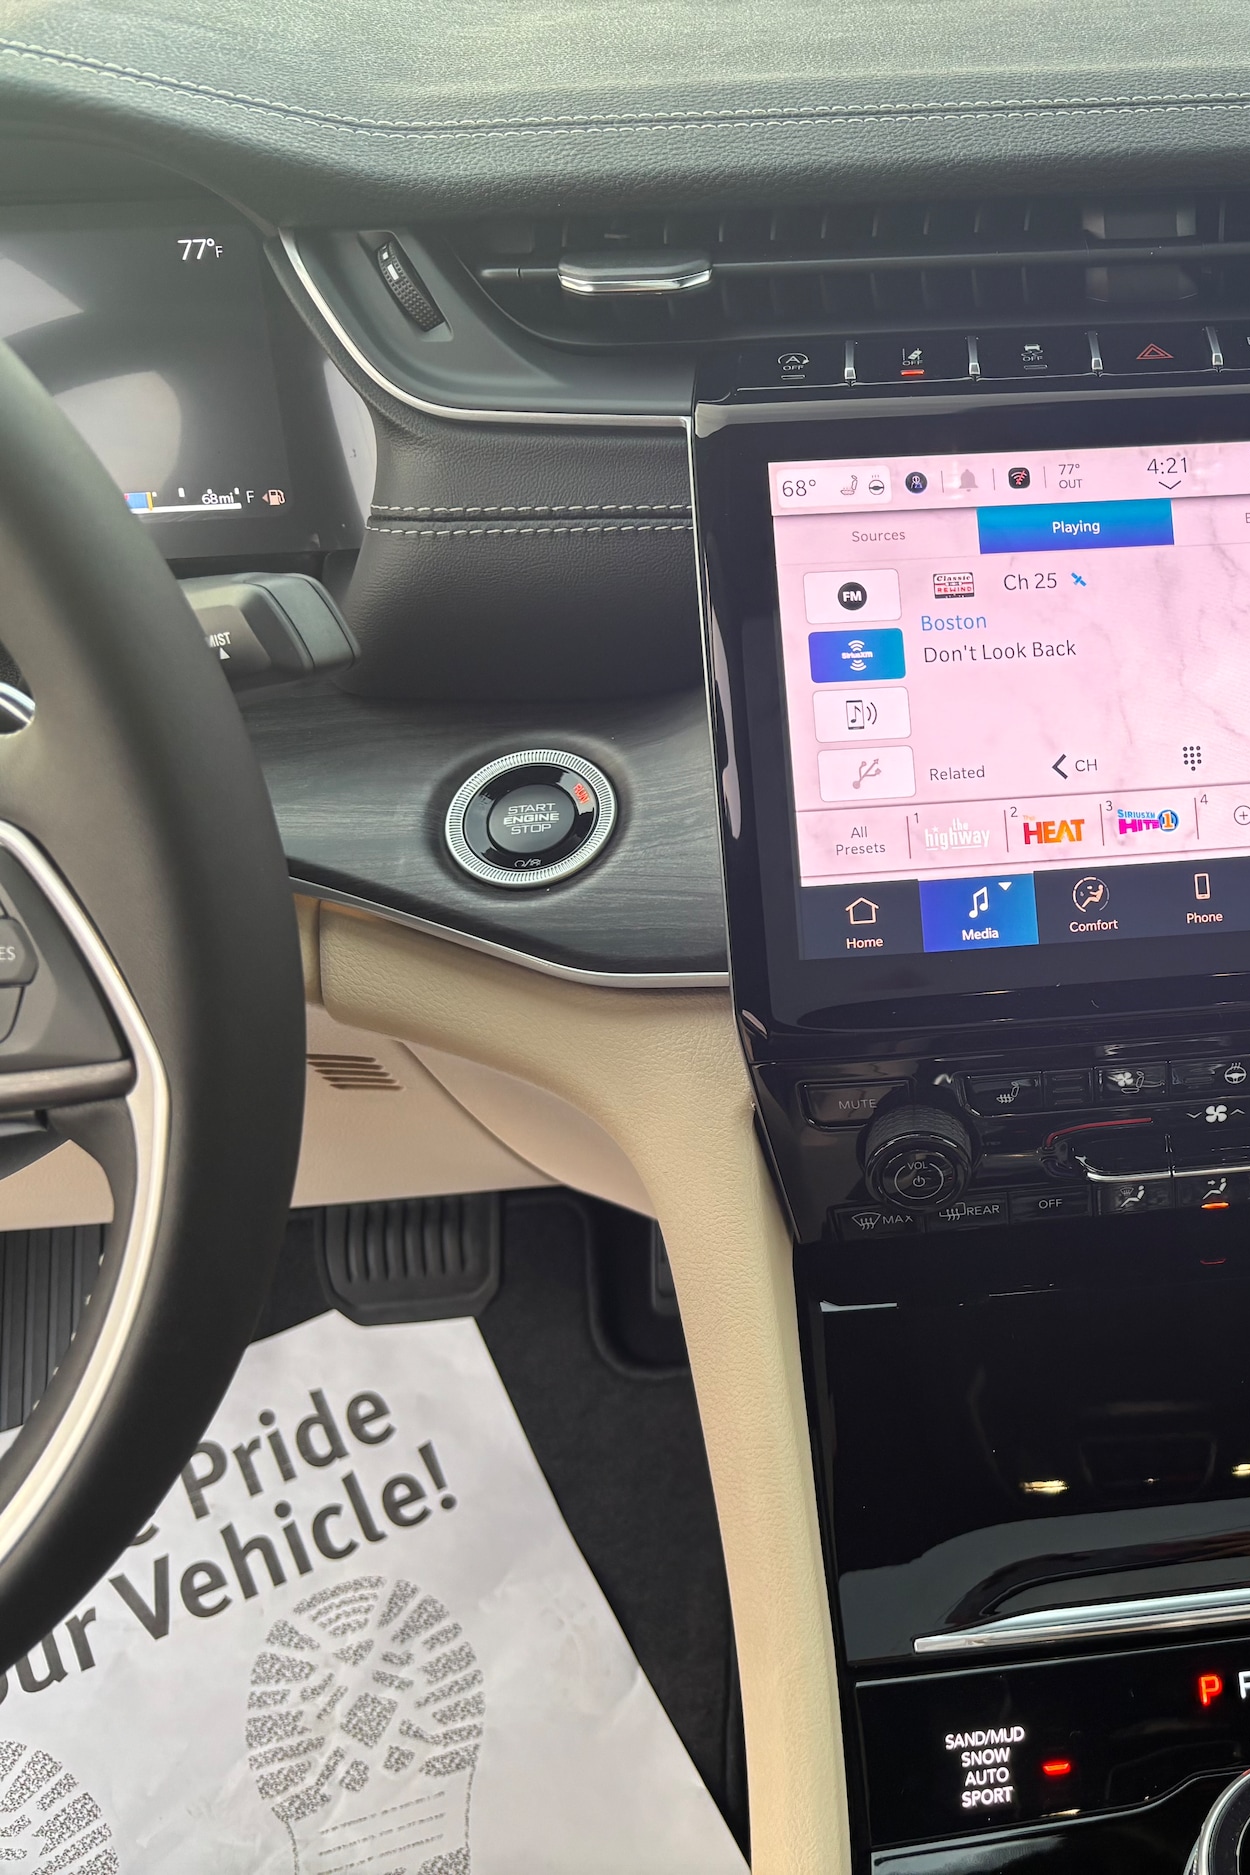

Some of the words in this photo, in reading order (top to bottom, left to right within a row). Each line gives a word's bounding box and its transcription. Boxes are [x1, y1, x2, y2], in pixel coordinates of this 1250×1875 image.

[1058, 464, 1080, 476] 77°
[1147, 457, 1188, 474] 4:21
[782, 479, 816, 498] 68°
[1059, 478, 1082, 489] OUT
[246, 491, 255, 503] F
[1052, 520, 1101, 535] Playing
[852, 529, 906, 543] Sources
[936, 573, 971, 583] Classic
[1003, 574, 1029, 591] Ch
[1034, 573, 1057, 589] 25
[937, 585, 972, 593] REWIND
[842, 590, 862, 602] FM
[921, 615, 987, 631] Boston
[923, 645, 977, 663] Don't
[982, 643, 1026, 661] Look
[1033, 639, 1076, 658] Back
[1075, 758, 1098, 772] CH
[929, 766, 985, 781] Related
[573, 783, 590, 804] RUN
[1200, 795, 1208, 804] 4
[507, 803, 556, 815] START
[1010, 807, 1018, 818] 2
[1105, 801, 1113, 811] 3
[503, 812, 560, 825] ENGINE
[914, 813, 920, 824] 1
[952, 818, 969, 832] the
[511, 823, 552, 835] STOP
[850, 825, 867, 839] All
[1024, 818, 1085, 844] HEAT
[925, 826, 990, 849] highway
[836, 841, 886, 857] Presets
[1186, 911, 1223, 924] Phone
[1069, 919, 1118, 932] Comfort
[962, 928, 999, 941] Media
[846, 936, 883, 949] Home
[838, 1099, 878, 1110] MUTE
[907, 1161, 928, 1171] VOL
[966, 1205, 1000, 1216] REAR
[1038, 1199, 1062, 1209] OFF
[883, 1213, 913, 1225] MAX
[179, 1388, 397, 1520] Pride
[0, 1606, 97, 1701] ur
[109, 1439, 458, 1641] Vehicle!
[1200, 1674, 1222, 1705] P
[944, 1725, 1025, 1751] SAND/MUD
[961, 1747, 1011, 1767] SNOW
[965, 1767, 1010, 1787] AUTO
[961, 1785, 1014, 1808] SPORT
